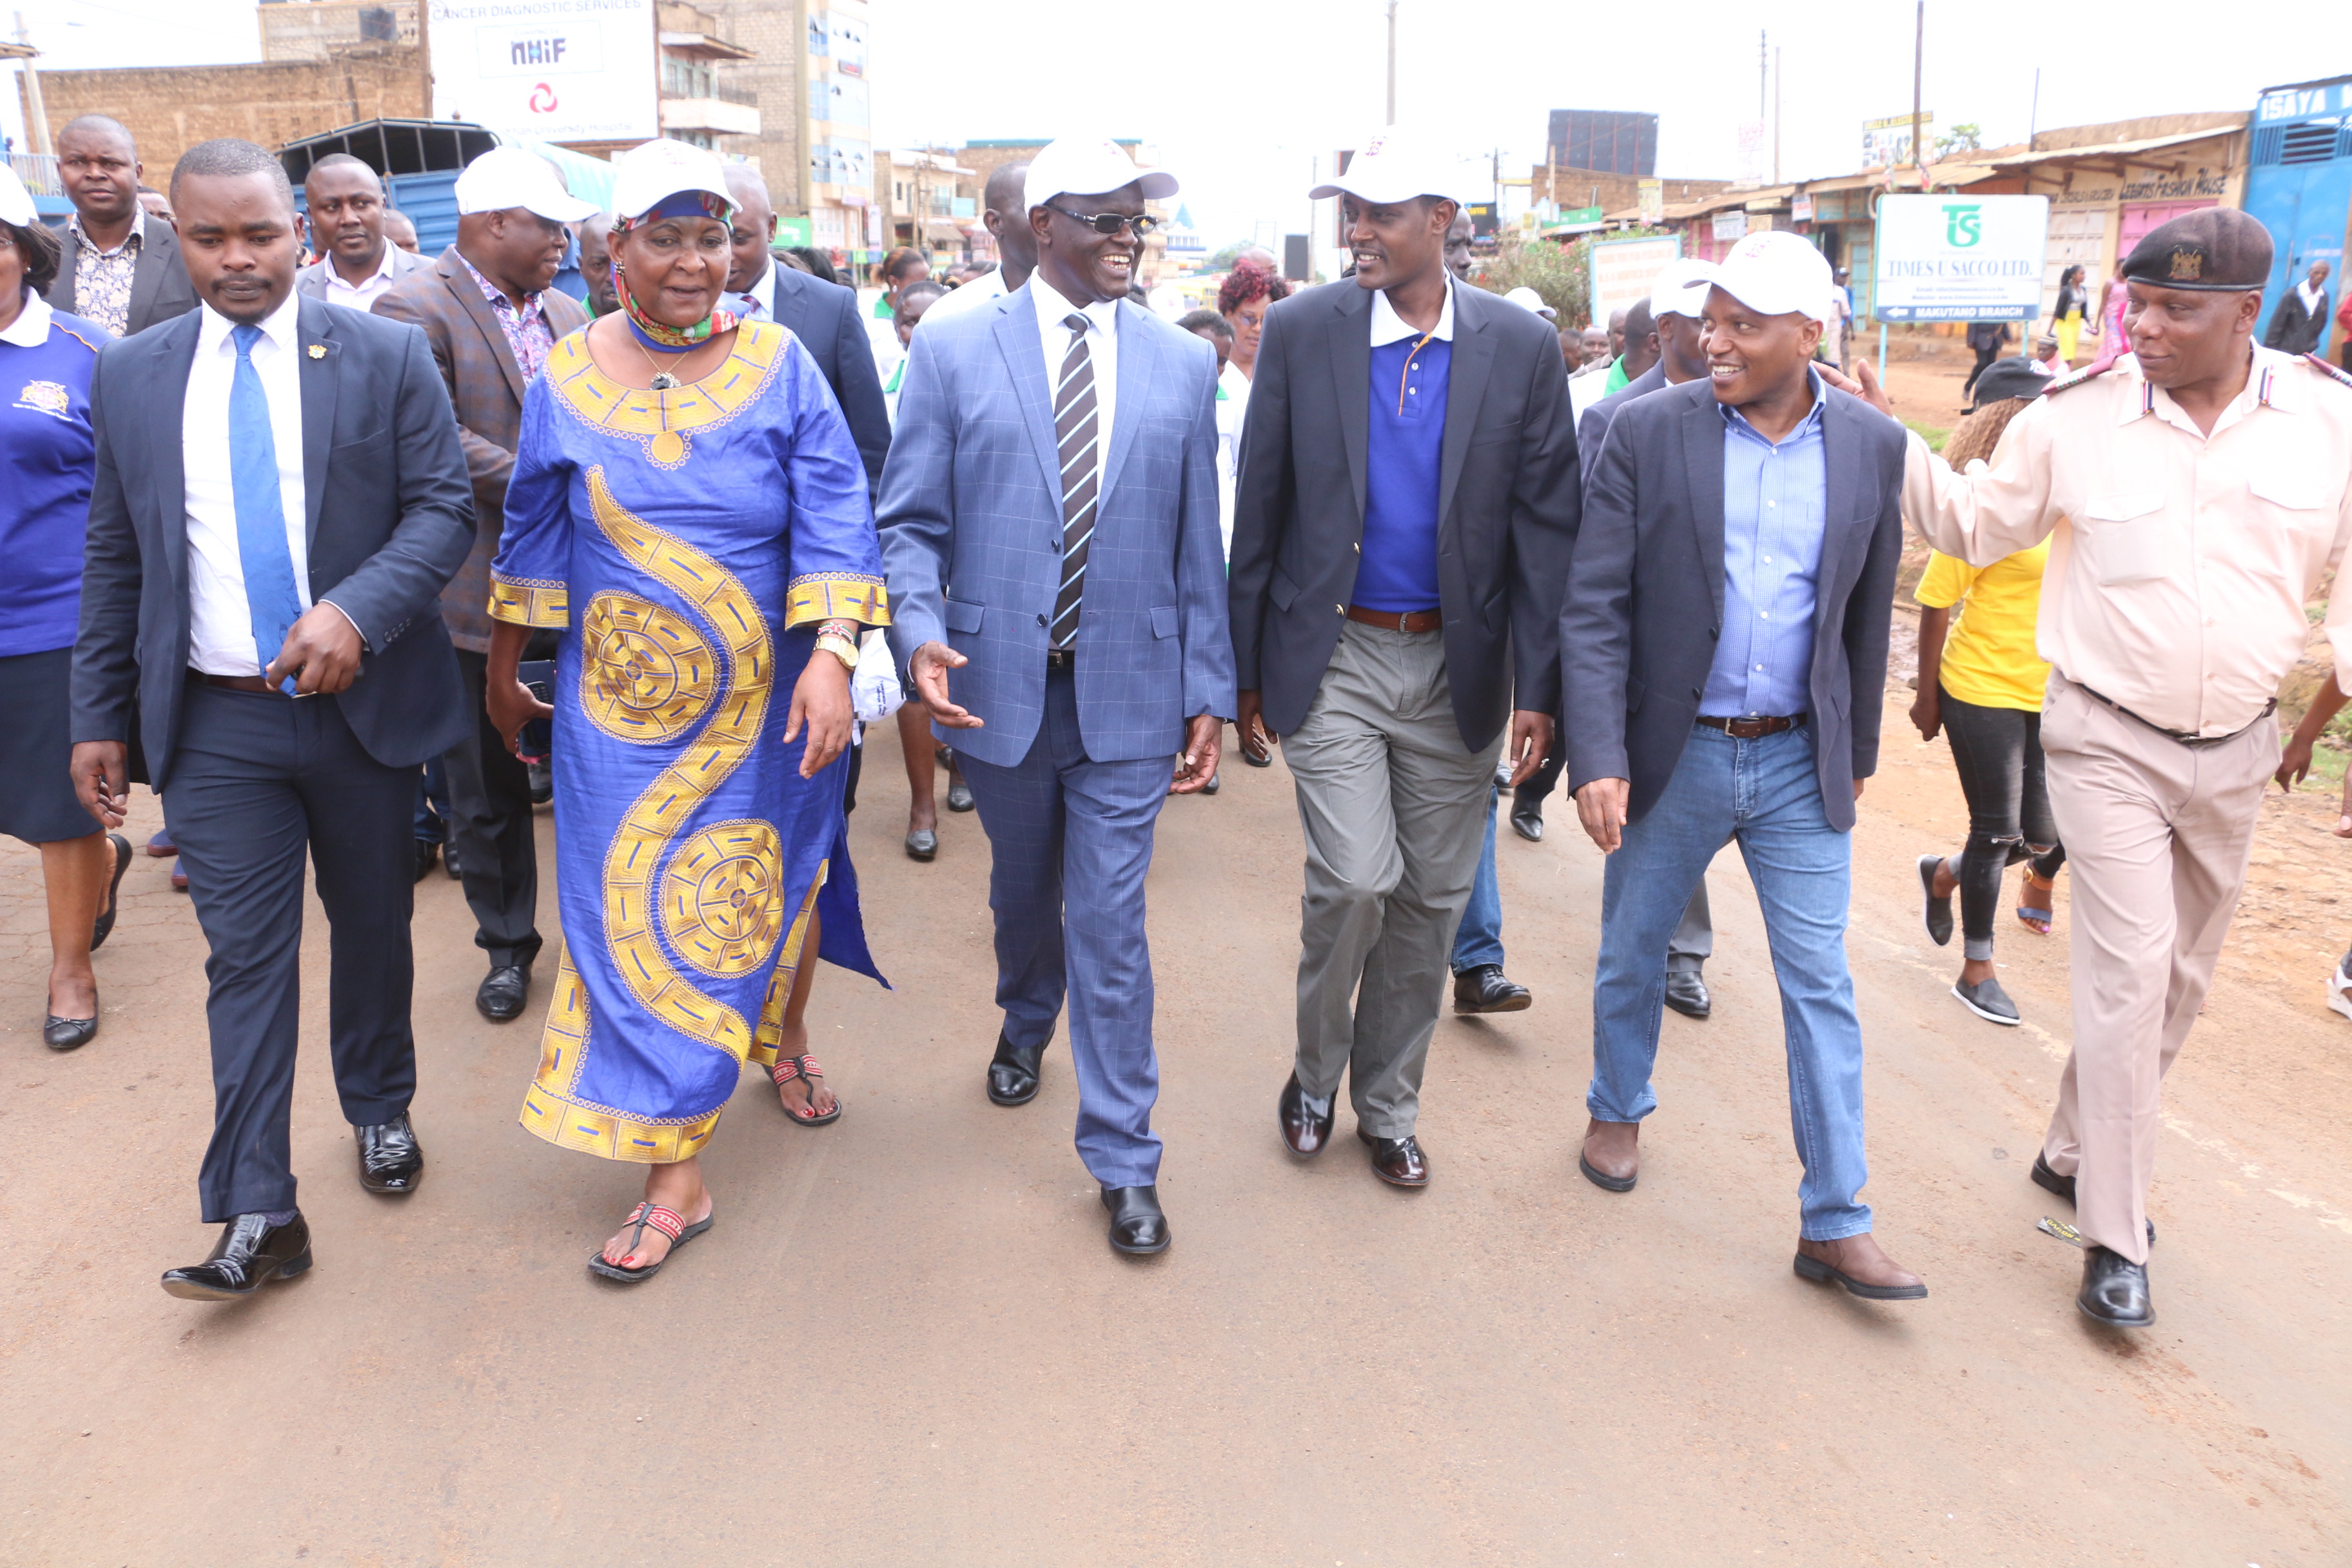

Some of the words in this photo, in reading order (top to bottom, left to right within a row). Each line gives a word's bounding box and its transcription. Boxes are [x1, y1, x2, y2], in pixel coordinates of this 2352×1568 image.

[433, 6, 487, 21] CANCER
[491, 1, 573, 17] DIAGNOSTIC
[576, 0, 642, 12] SERVICES
[2260, 88, 2326, 121] ISAYA
[589, 121, 632, 133] Hospital
[1738, 118, 1765, 136] EGGS
[2195, 168, 2228, 195] HOUSE
[1887, 260, 1934, 277] TIMES
[1938, 260, 1948, 277] U
[1952, 259, 1998, 277] SACCO
[2001, 259, 2034, 277] LTD.
[1915, 307, 1977, 317] MAKUTANO
[1978, 306, 2024, 317] BRANCH
